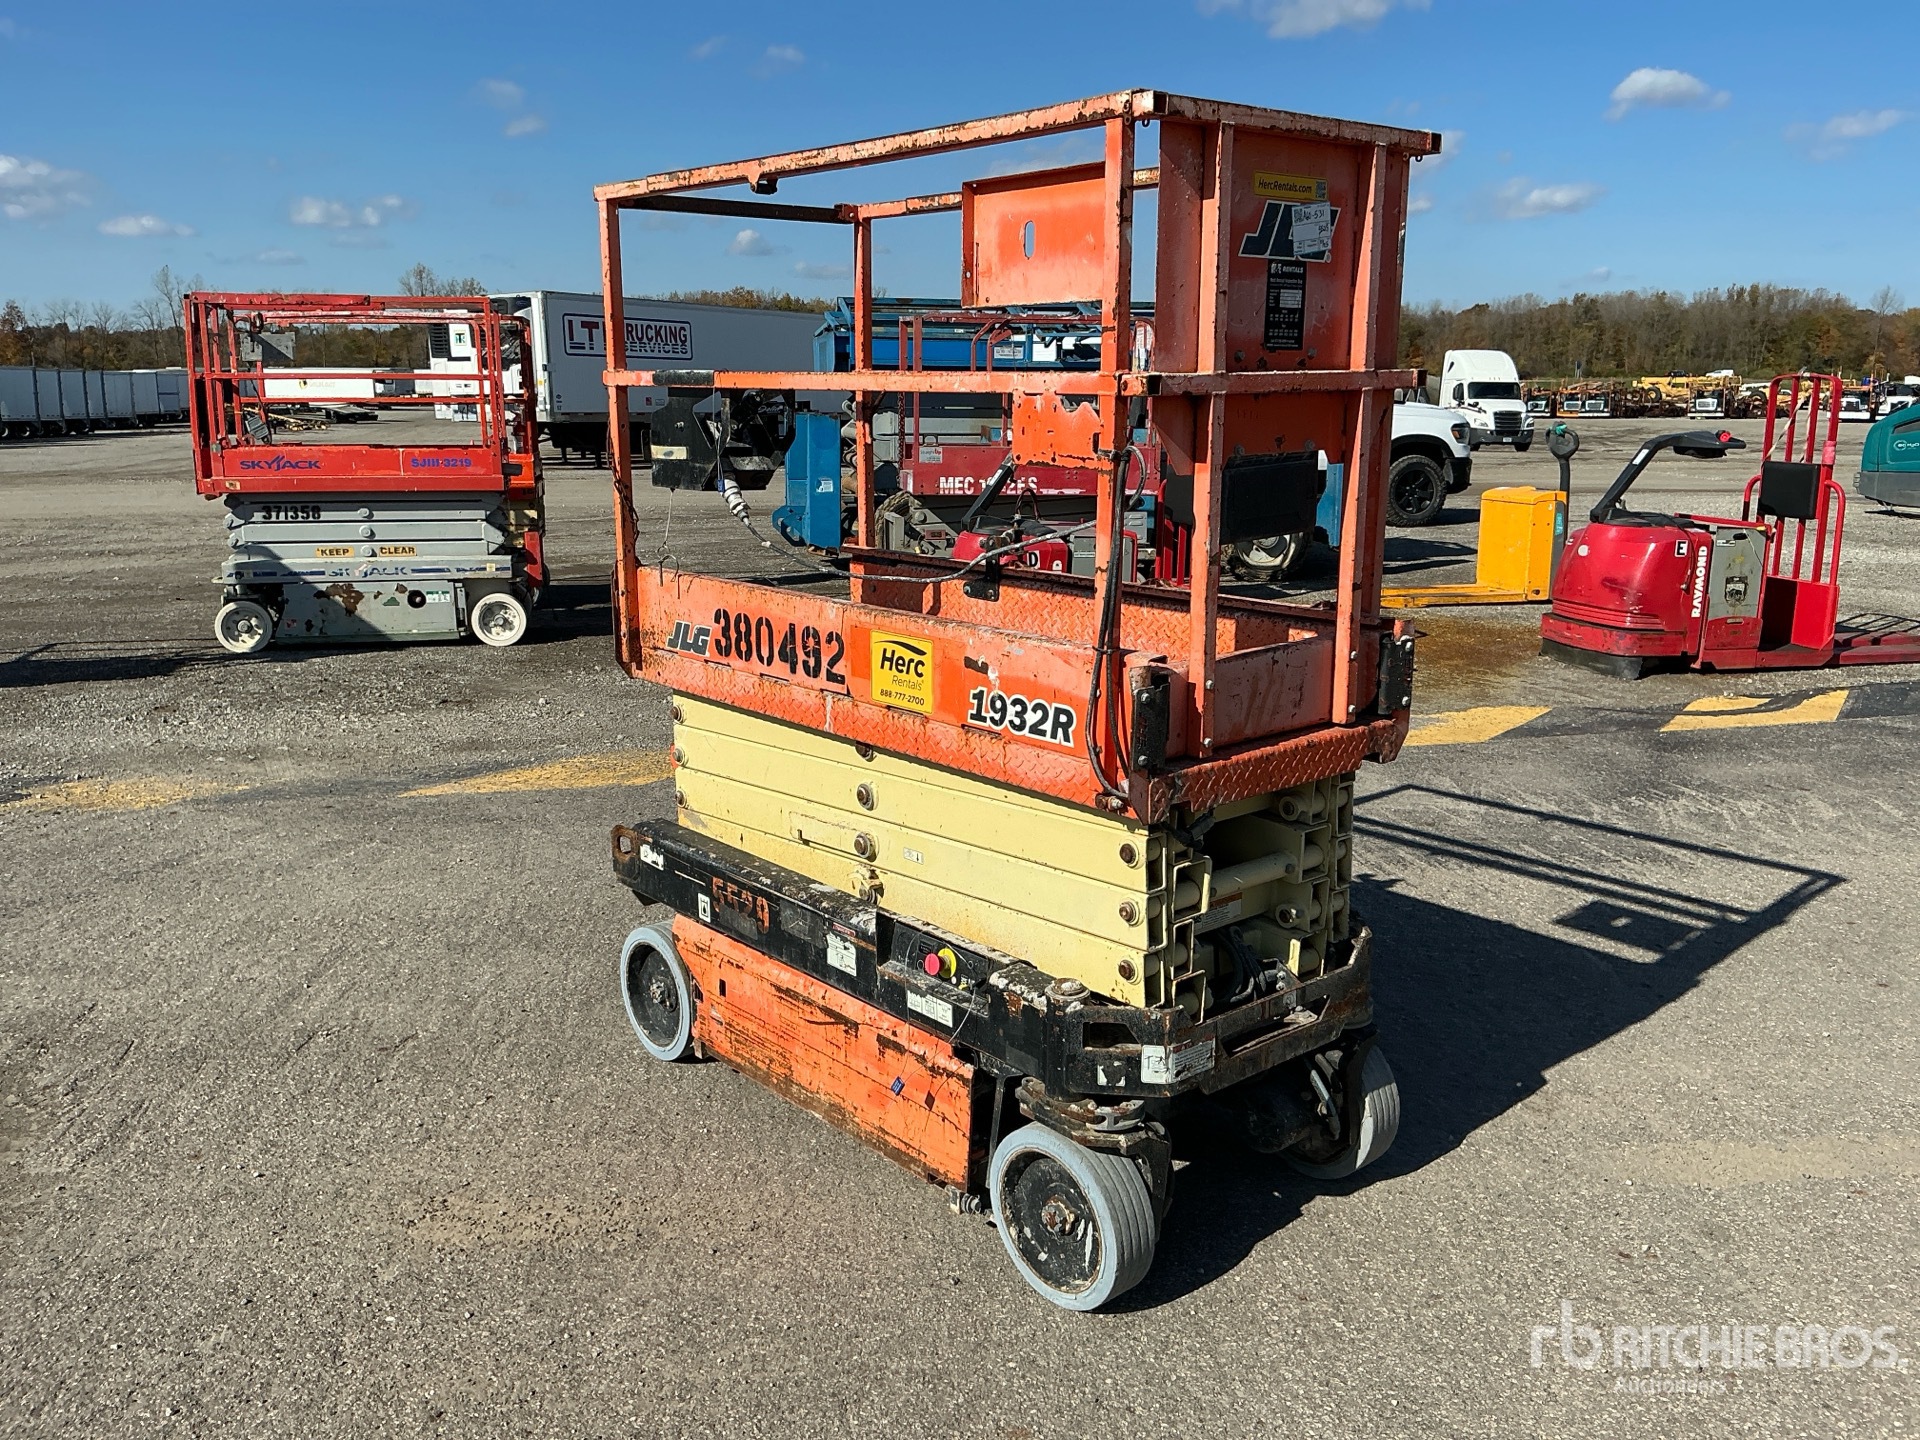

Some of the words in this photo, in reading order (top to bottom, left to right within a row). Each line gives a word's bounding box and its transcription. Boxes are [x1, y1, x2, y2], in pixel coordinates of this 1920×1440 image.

[1258, 179, 1312, 194] HercRentals.com
[625, 322, 687, 344] RUCKING
[625, 340, 688, 355] SERVICES
[240, 455, 322, 472] SKYJACK
[940, 476, 974, 495] MEC
[261, 505, 321, 520] 371358
[321, 547, 350, 556] KEEP
[380, 546, 415, 556] CLEAR
[1676, 541, 1687, 556] E
[1029, 552, 1039, 567] D
[1691, 546, 1708, 617] RAYMOND
[667, 620, 712, 657] JLG
[714, 608, 846, 685] 380492
[880, 647, 926, 678] Herc
[891, 675, 924, 691] Rentals
[879, 688, 925, 706] 888-777-2700
[967, 686, 1077, 747] 1932R
